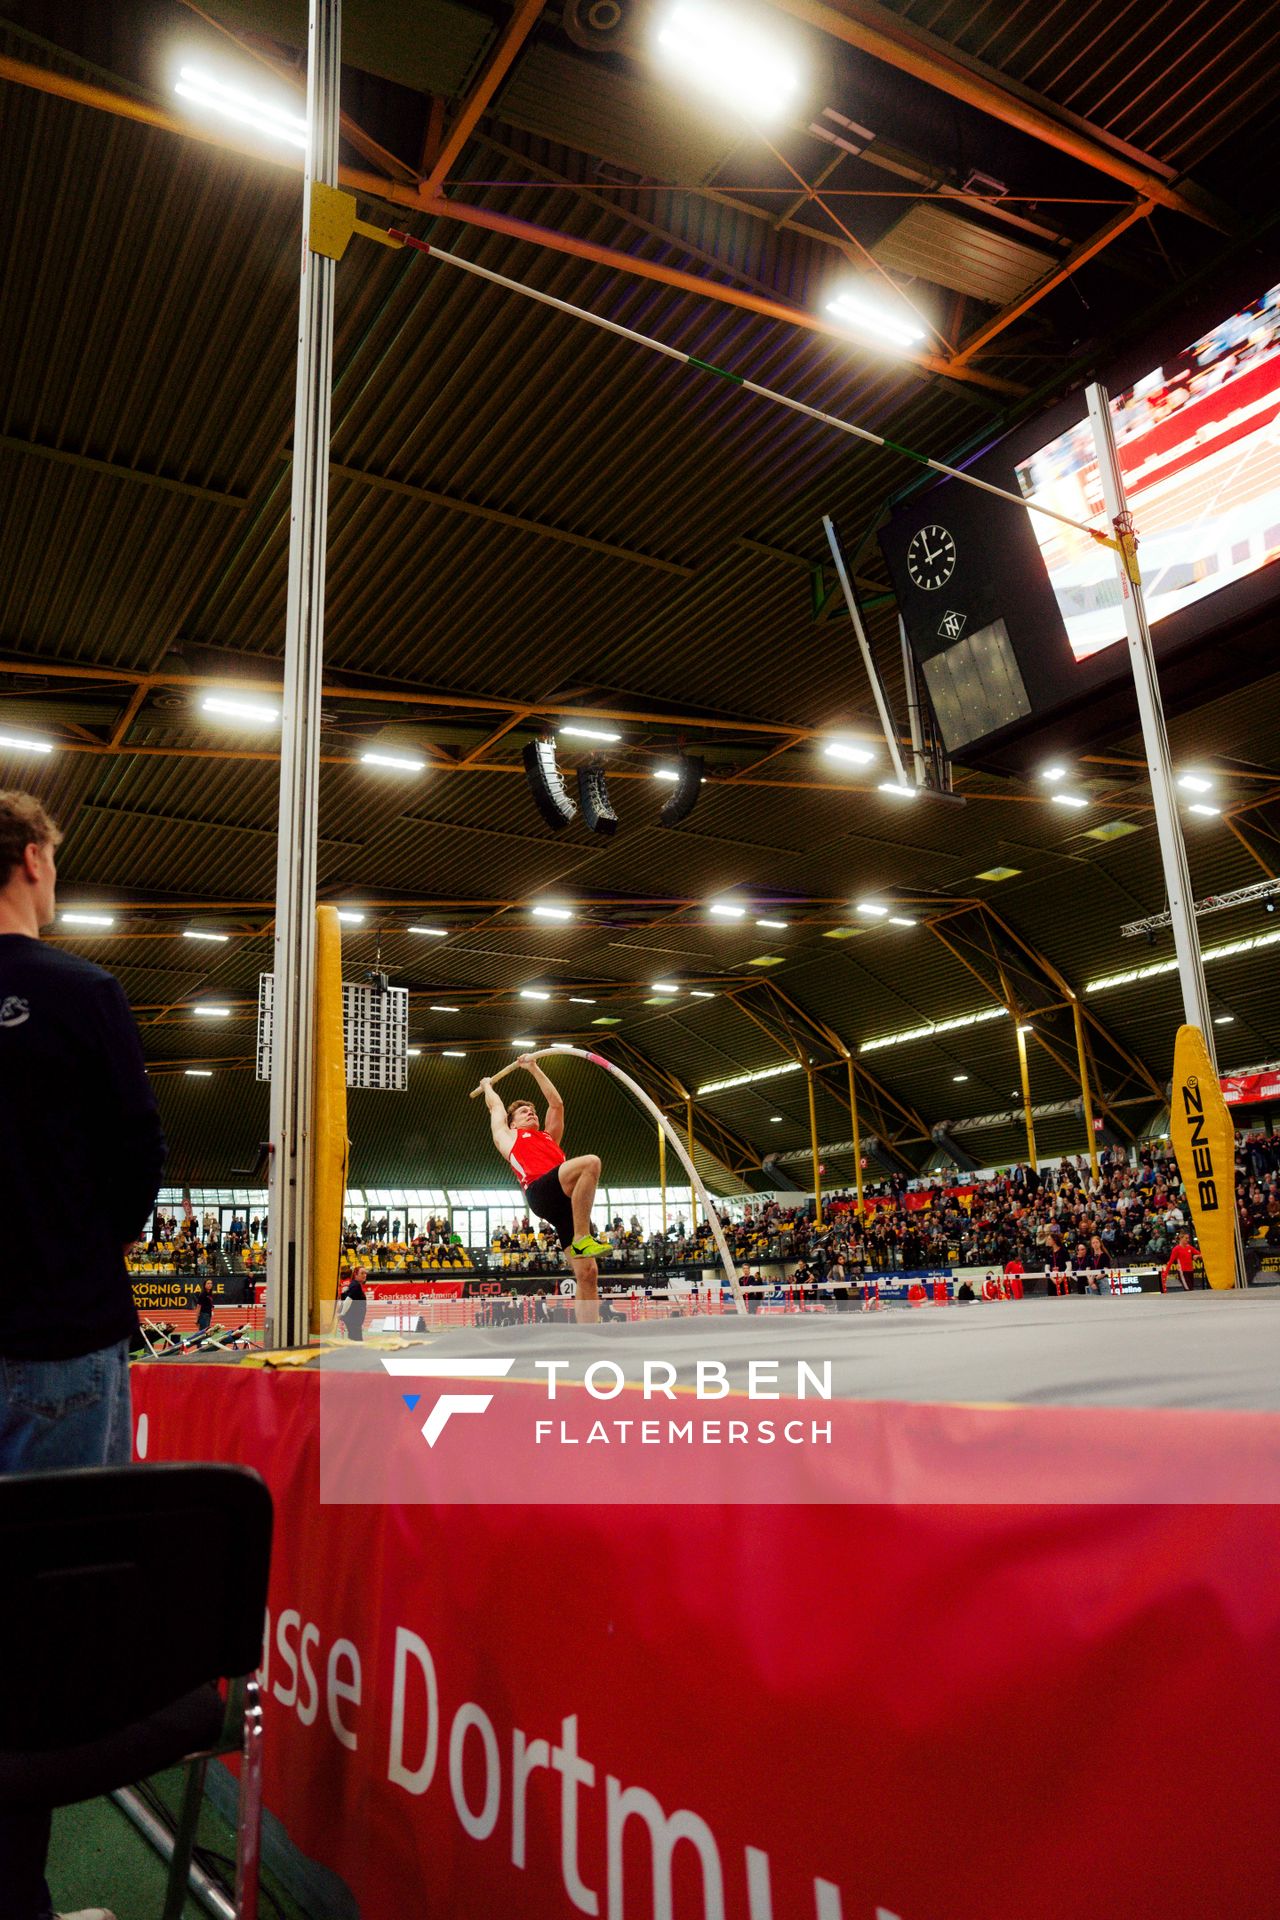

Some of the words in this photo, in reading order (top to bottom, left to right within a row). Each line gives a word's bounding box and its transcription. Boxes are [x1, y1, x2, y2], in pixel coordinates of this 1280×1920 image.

[1182, 1084, 1219, 1211] BENZ
[1261, 1257, 1280, 1265] JETZ
[131, 1283, 181, 1294] KÖRNIG
[184, 1283, 225, 1294] HAE
[563, 1282, 574, 1294] 21
[419, 1289, 458, 1300] Dtmund
[132, 1295, 188, 1308] RTMUND
[387, 1625, 901, 1920] Dortm
